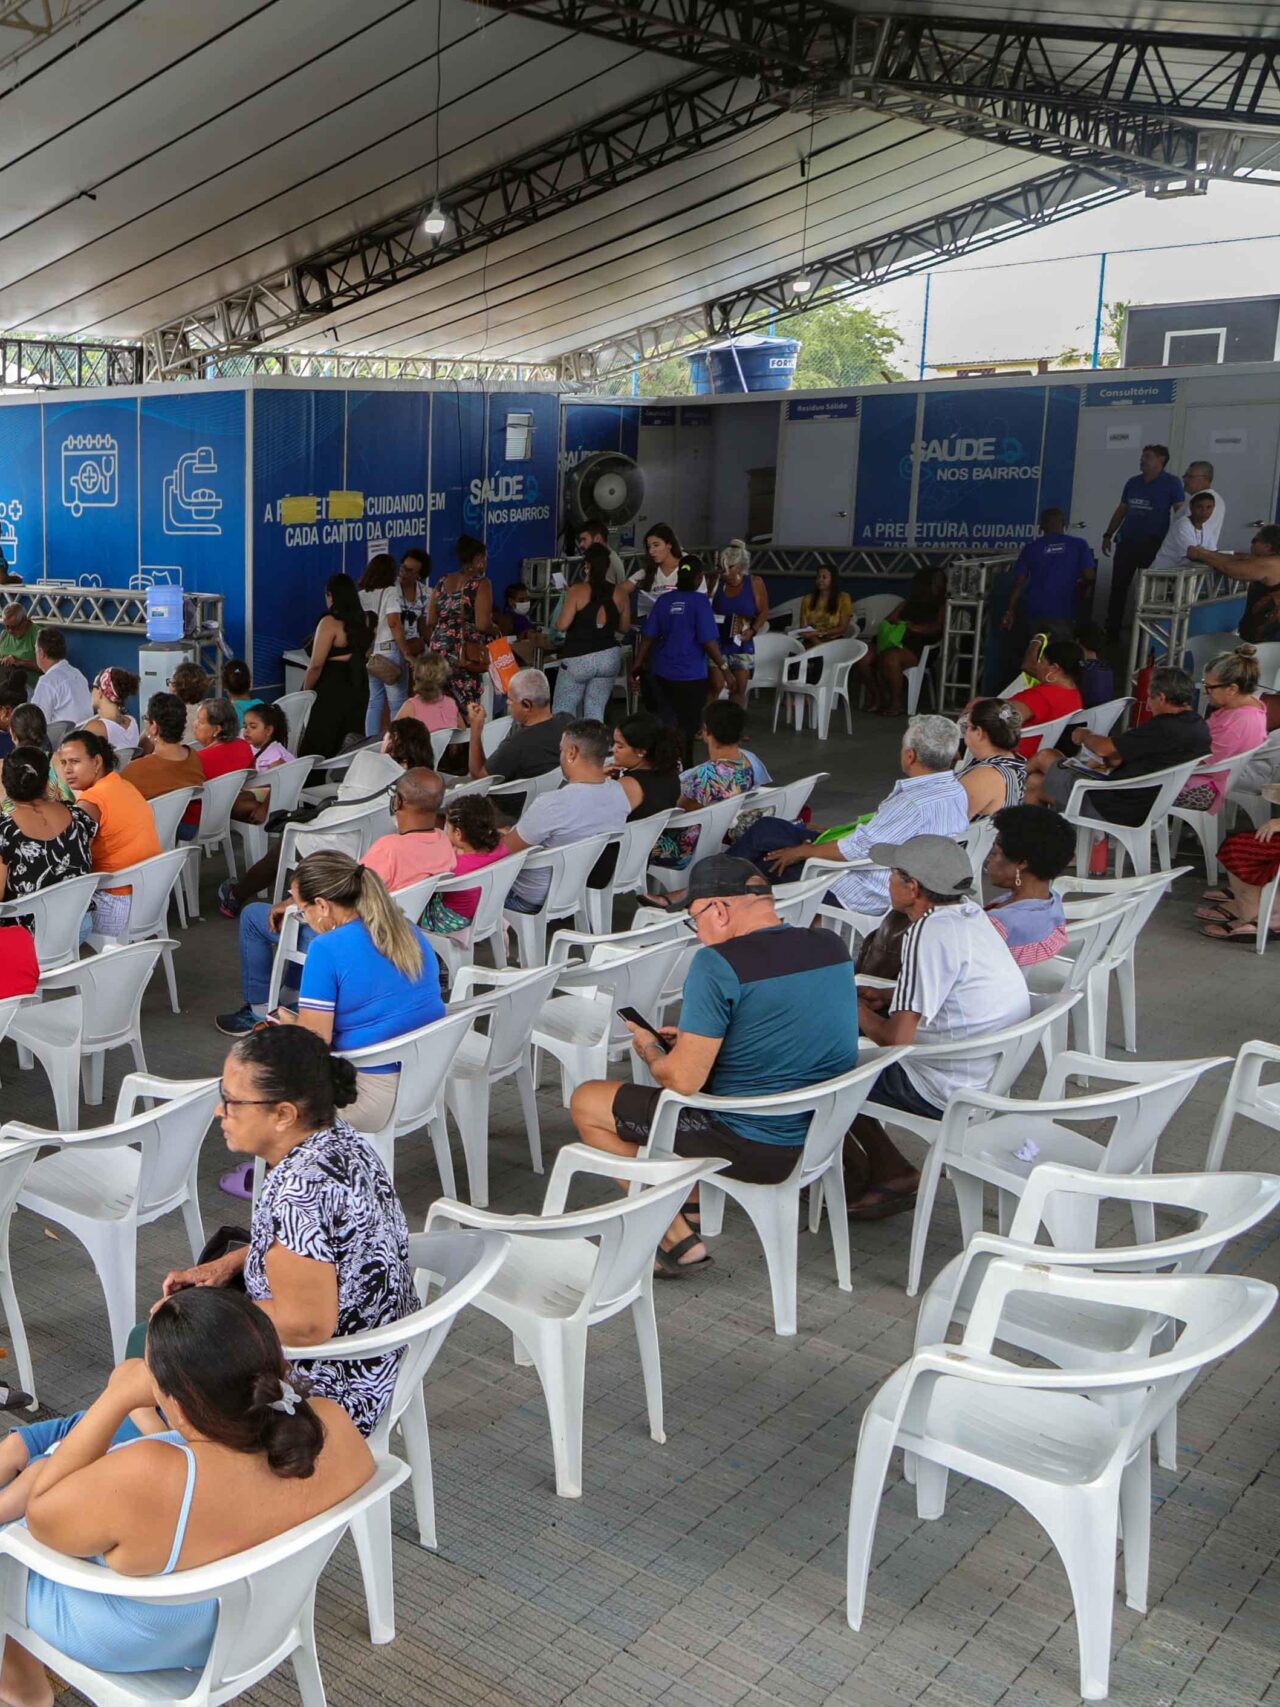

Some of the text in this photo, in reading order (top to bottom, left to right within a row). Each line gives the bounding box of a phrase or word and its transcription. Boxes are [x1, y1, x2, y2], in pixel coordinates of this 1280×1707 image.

[1099, 387, 1159, 398] Consultório
[910, 433, 996, 462] SAÚDE
[936, 466, 1042, 481] NOS BAIRROS
[470, 470, 524, 505] SAÚDE
[264, 503, 273, 523] A
[366, 494, 424, 516] CUIDANDO
[430, 492, 446, 511] EM
[487, 505, 550, 524] NOS BAIRROS
[285, 526, 319, 547] CADA
[366, 521, 382, 540] DA
[385, 518, 426, 538] CIDADE
[862, 525, 872, 538] A
